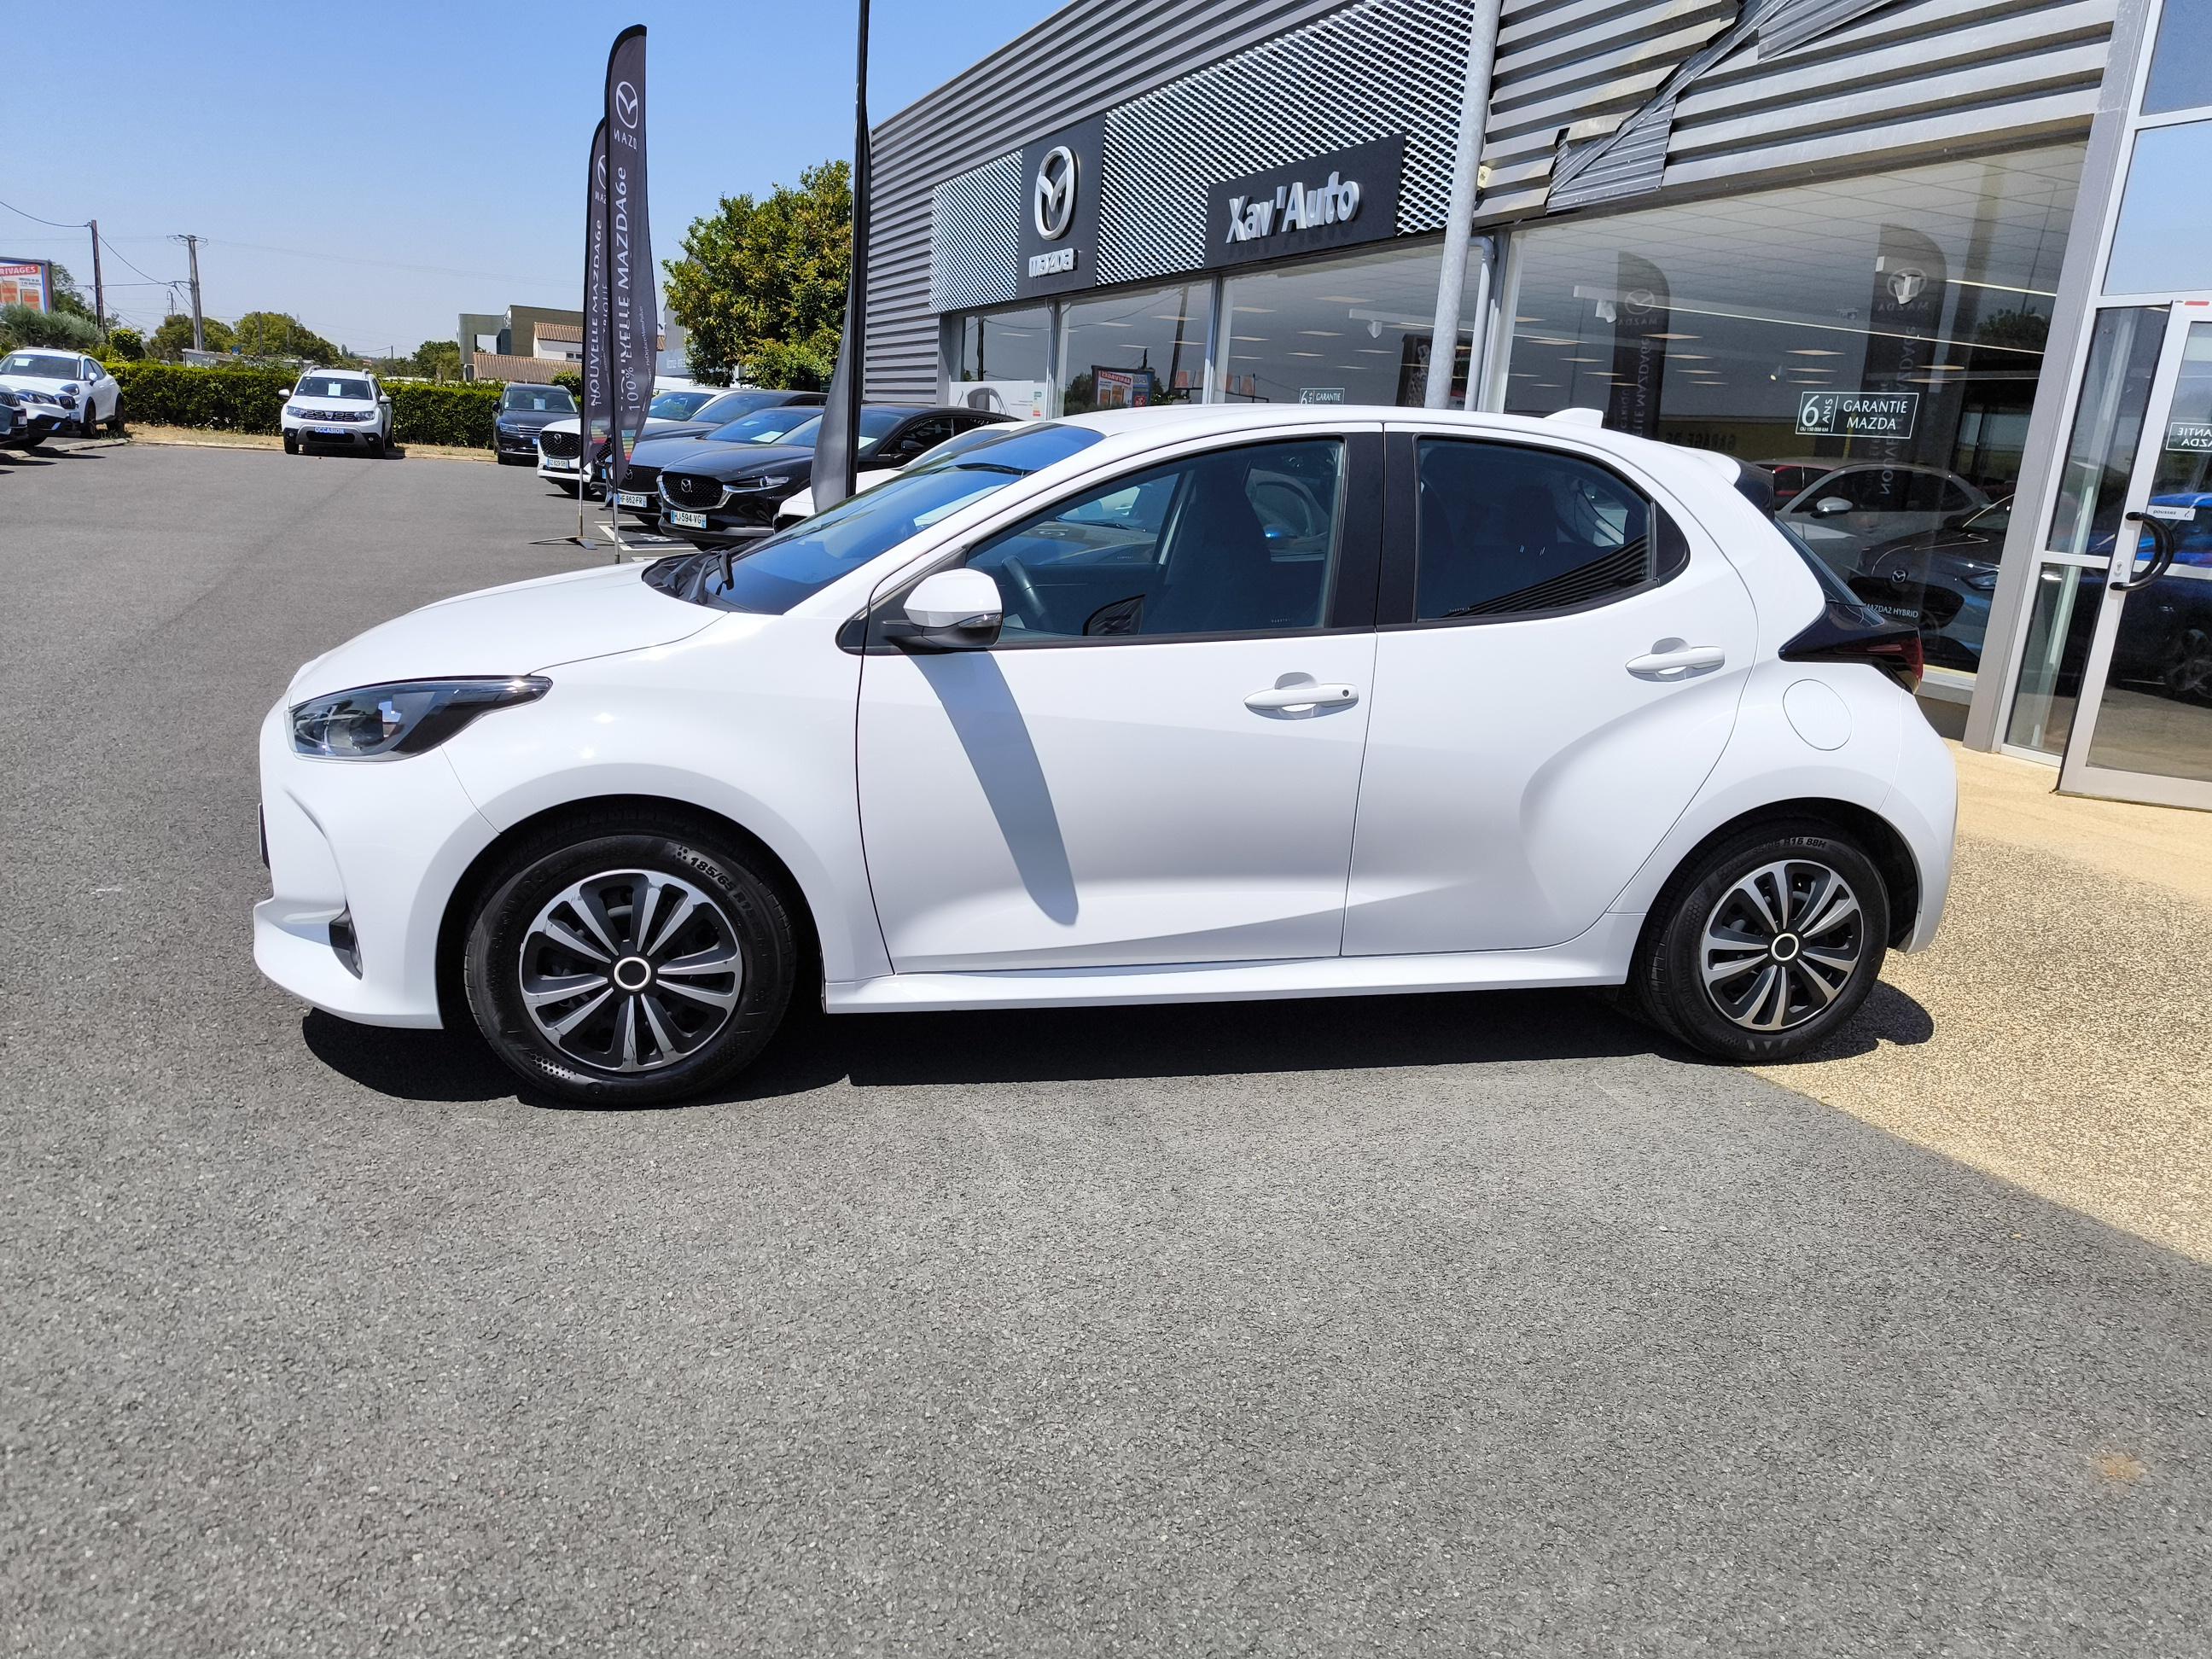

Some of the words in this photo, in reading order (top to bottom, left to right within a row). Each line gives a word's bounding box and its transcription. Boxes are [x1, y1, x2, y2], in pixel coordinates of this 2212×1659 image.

[1226, 171, 1360, 244] Xav'Auto
[615, 166, 630, 290] MAZDA6e
[591, 219, 603, 311] MAZDA6e
[625, 366, 641, 411] 100%
[1316, 393, 1341, 401] GARANTIE
[1802, 395, 1819, 427] 6
[1822, 399, 1834, 424] ANS
[1843, 400, 1908, 414] GARANTIE
[1847, 416, 1896, 430] MAZDA
[1893, 608, 1919, 618] HYBRID
[1806, 838, 1826, 848] 88H
[690, 857, 736, 891] 185/65
